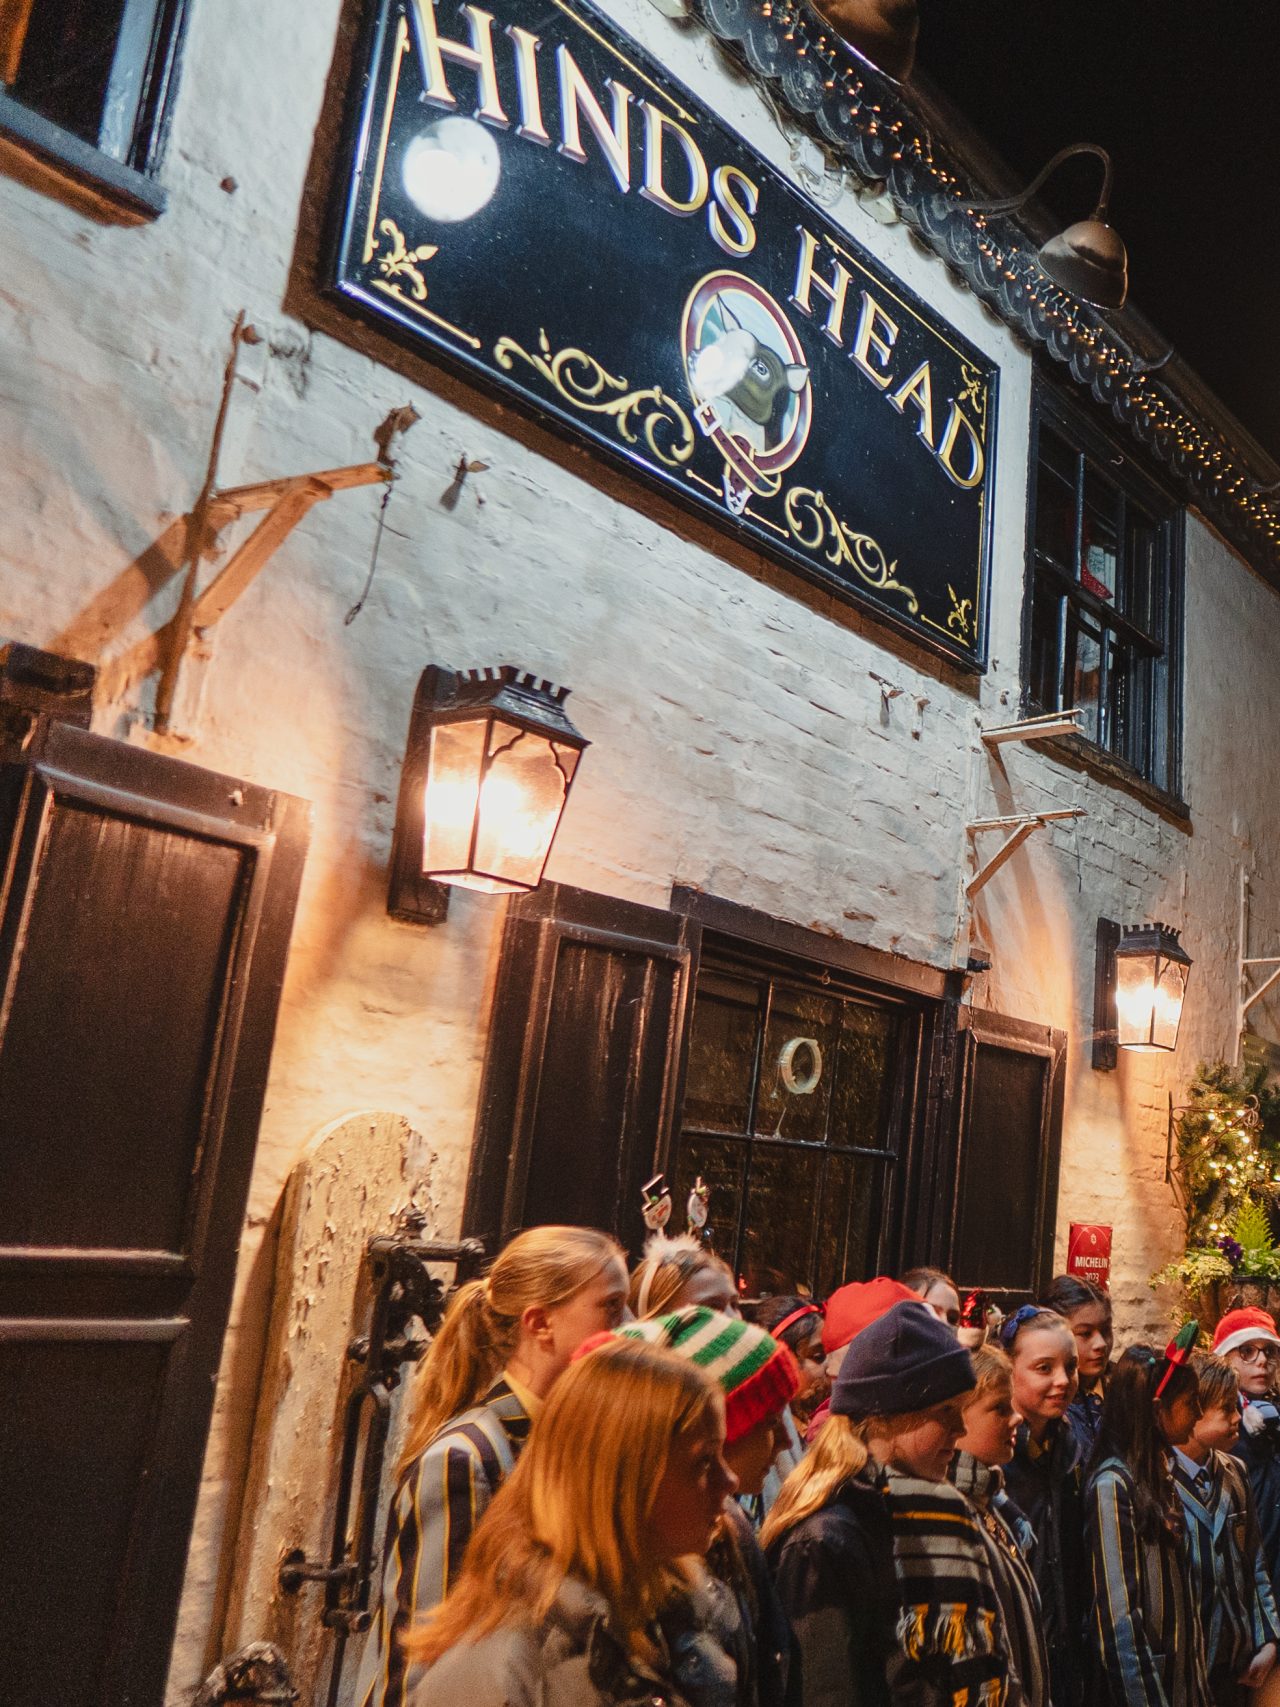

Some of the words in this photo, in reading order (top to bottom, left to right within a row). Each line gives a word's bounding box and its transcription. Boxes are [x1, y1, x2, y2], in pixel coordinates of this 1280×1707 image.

[408, 0, 760, 258] HINDS
[788, 225, 984, 489] HEAD
[1075, 1256, 1108, 1268] MICHELIN
